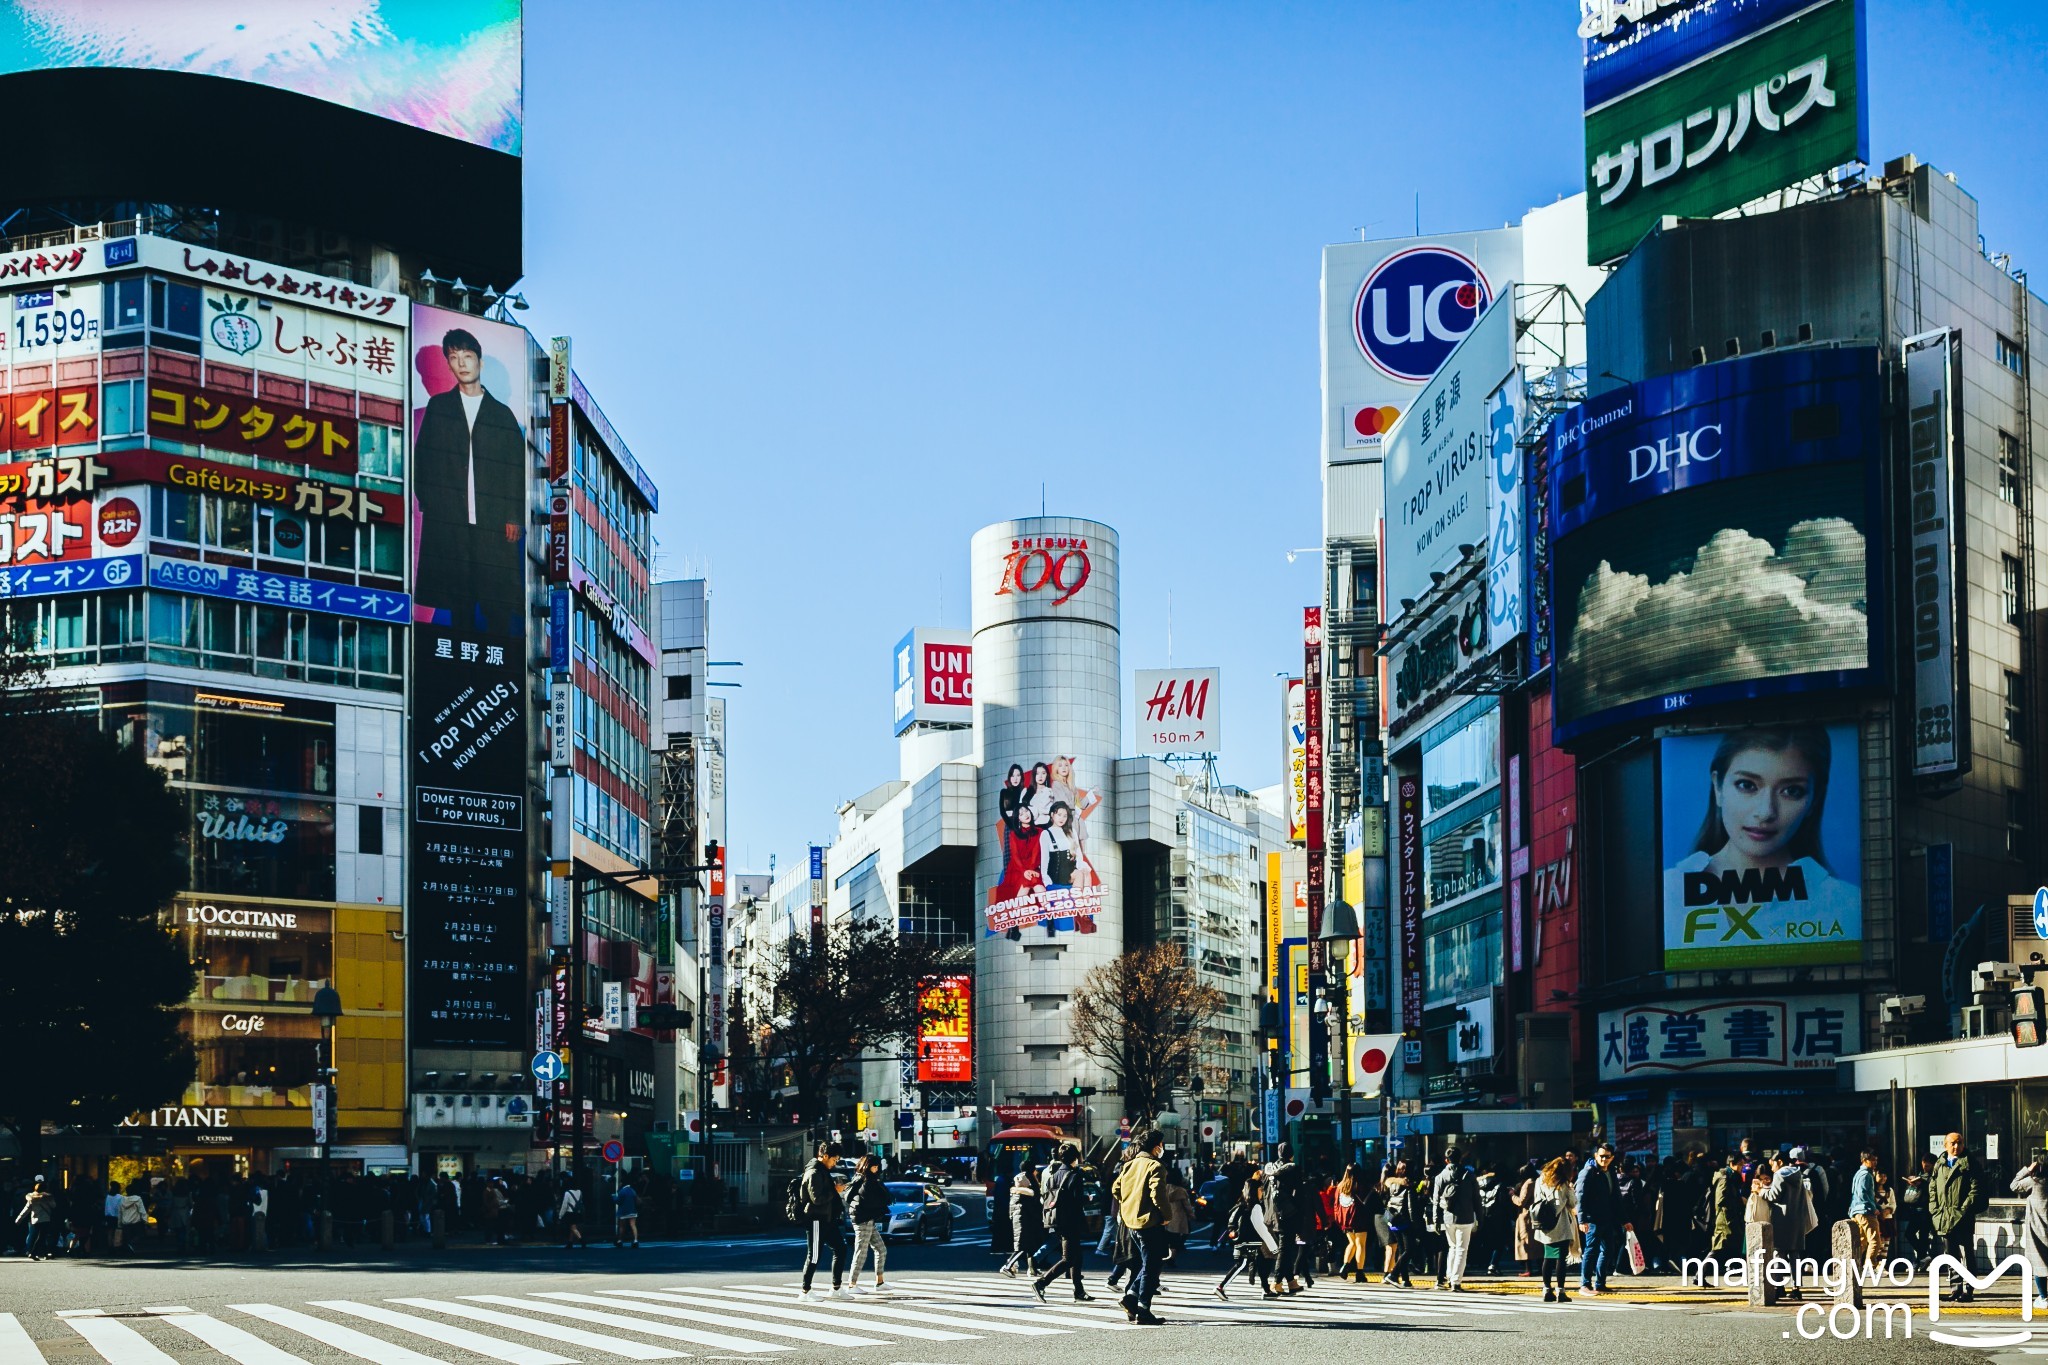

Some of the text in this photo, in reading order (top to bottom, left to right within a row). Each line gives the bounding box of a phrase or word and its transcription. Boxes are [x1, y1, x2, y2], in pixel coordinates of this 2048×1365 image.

[1592, 54, 1836, 205] サロンパス
[0, 247, 87, 279] バイキング
[183, 247, 397, 317] しゃぶしゃぶバイキング
[275, 316, 396, 375] しゃぶ葉
[0, 392, 97, 438] イス
[150, 388, 350, 456] コンタクト
[1421, 371, 1461, 445] 星野源
[1558, 400, 1634, 452] DHC Channel
[1629, 423, 1722, 484] DHC
[26, 458, 108, 498] ガスト
[294, 481, 384, 523] ガスト
[1489, 387, 1519, 632] もんじゃ
[103, 519, 137, 535] ガスト
[1012, 538, 1088, 551] SHIBUYA
[107, 563, 128, 580] 6F
[159, 562, 219, 587] AEON
[995, 550, 1091, 606] 109
[236, 571, 404, 616] 英会話イーオン
[1914, 544, 1941, 663] neon
[435, 638, 504, 665] 星野源
[1146, 678, 1210, 722] H&M
[1664, 694, 1692, 710] DHC
[452, 707, 519, 770] NOW ON SALE!
[555, 691, 566, 760] 渋谷駅前ビル
[1152, 732, 1190, 744] 150m
[422, 792, 516, 811] DOME TOUR 2019
[195, 811, 288, 844] Ushi8
[439, 855, 503, 868] 京セラドーム大阪
[1070, 884, 1109, 898] SALE
[1403, 812, 1416, 958] ウィンターフルーツギフト
[1428, 864, 1483, 903] Euphoria
[1683, 865, 1809, 907] DMM
[187, 905, 297, 928] L'OCCITANE
[207, 928, 278, 940] EN PROVENCE
[1017, 913, 1053, 926] HAPPY
[1053, 909, 1077, 919] NEW
[1078, 905, 1102, 915] YEAR
[1683, 905, 1764, 944] FX
[1786, 918, 1844, 939] ROLA
[221, 1014, 265, 1035] Café
[922, 1018, 969, 1036] SALE
[1603, 1007, 1845, 1068] 大盛堂書店
[629, 1069, 655, 1099] LUSH
